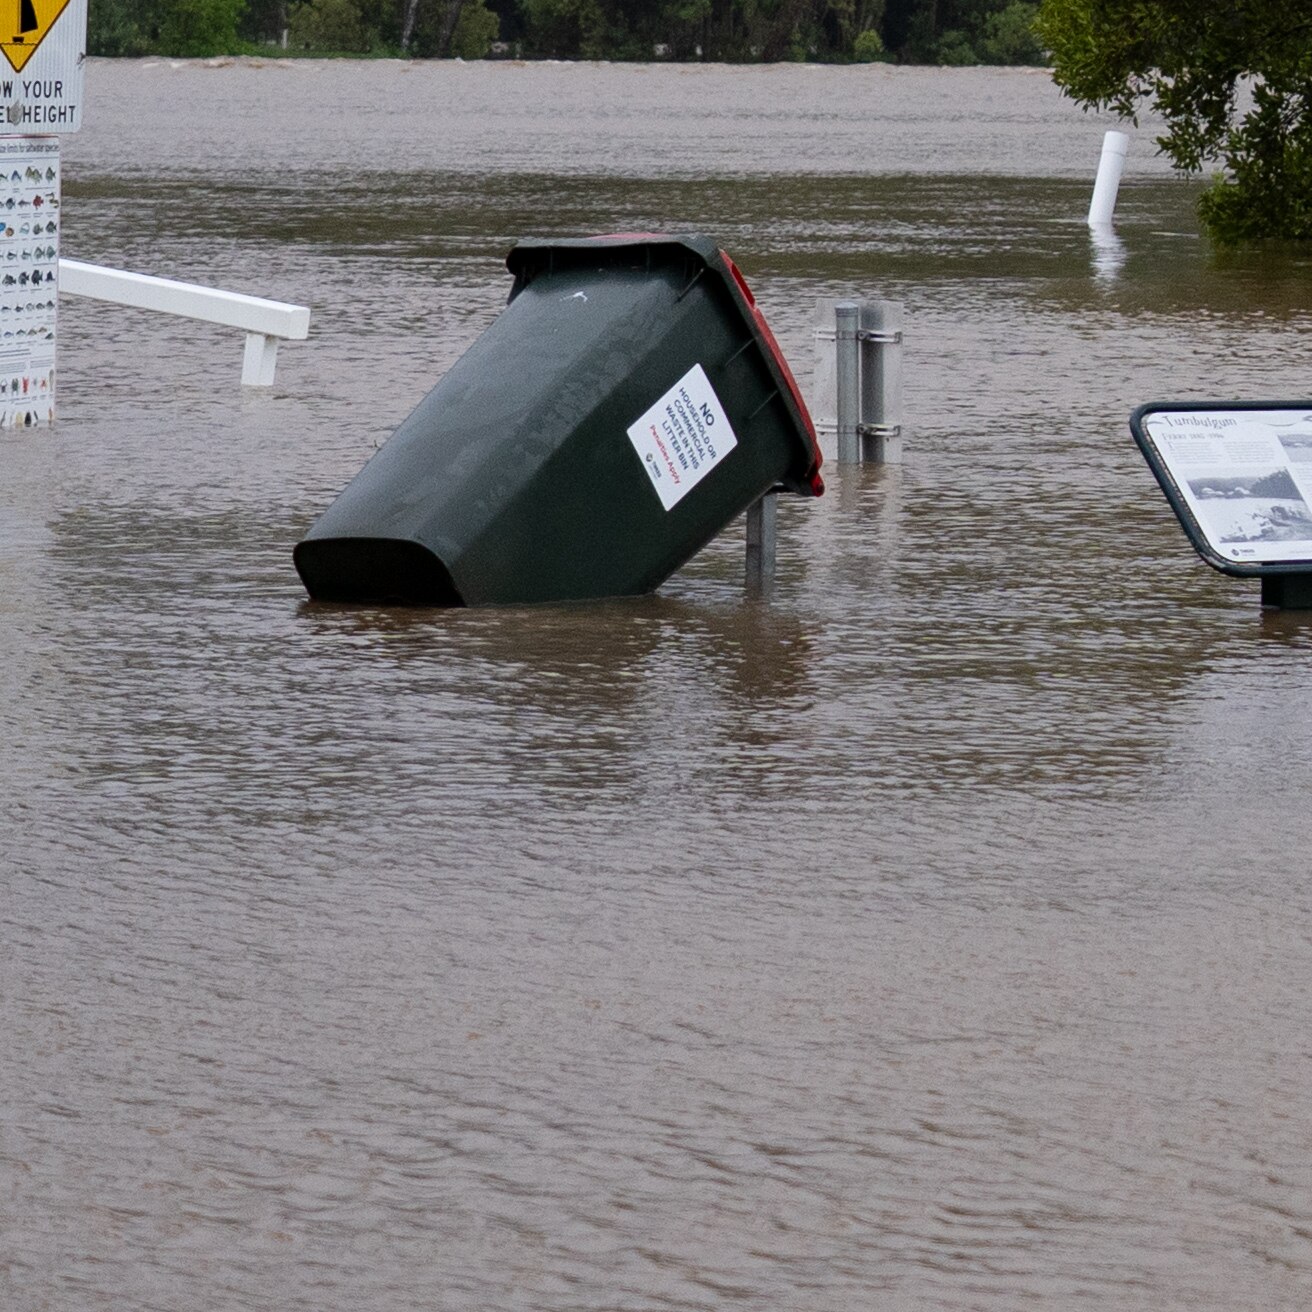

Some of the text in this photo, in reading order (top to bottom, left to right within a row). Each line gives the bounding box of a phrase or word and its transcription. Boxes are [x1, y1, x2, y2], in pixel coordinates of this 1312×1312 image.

[0, 80, 63, 99] W YOUR
[22, 105, 76, 123] HEIGHT
[665, 404, 700, 470] WASTE IN THIS
[674, 399, 705, 461] COMMERCIAL
[679, 387, 717, 460] HOUSEHOLD OR
[699, 402, 715, 426] NO
[1162, 415, 1238, 430] Tumbulgum
[650, 424, 670, 461] Penalties
[668, 461, 681, 484] Apply
[662, 420, 689, 471] LITTER BIN
